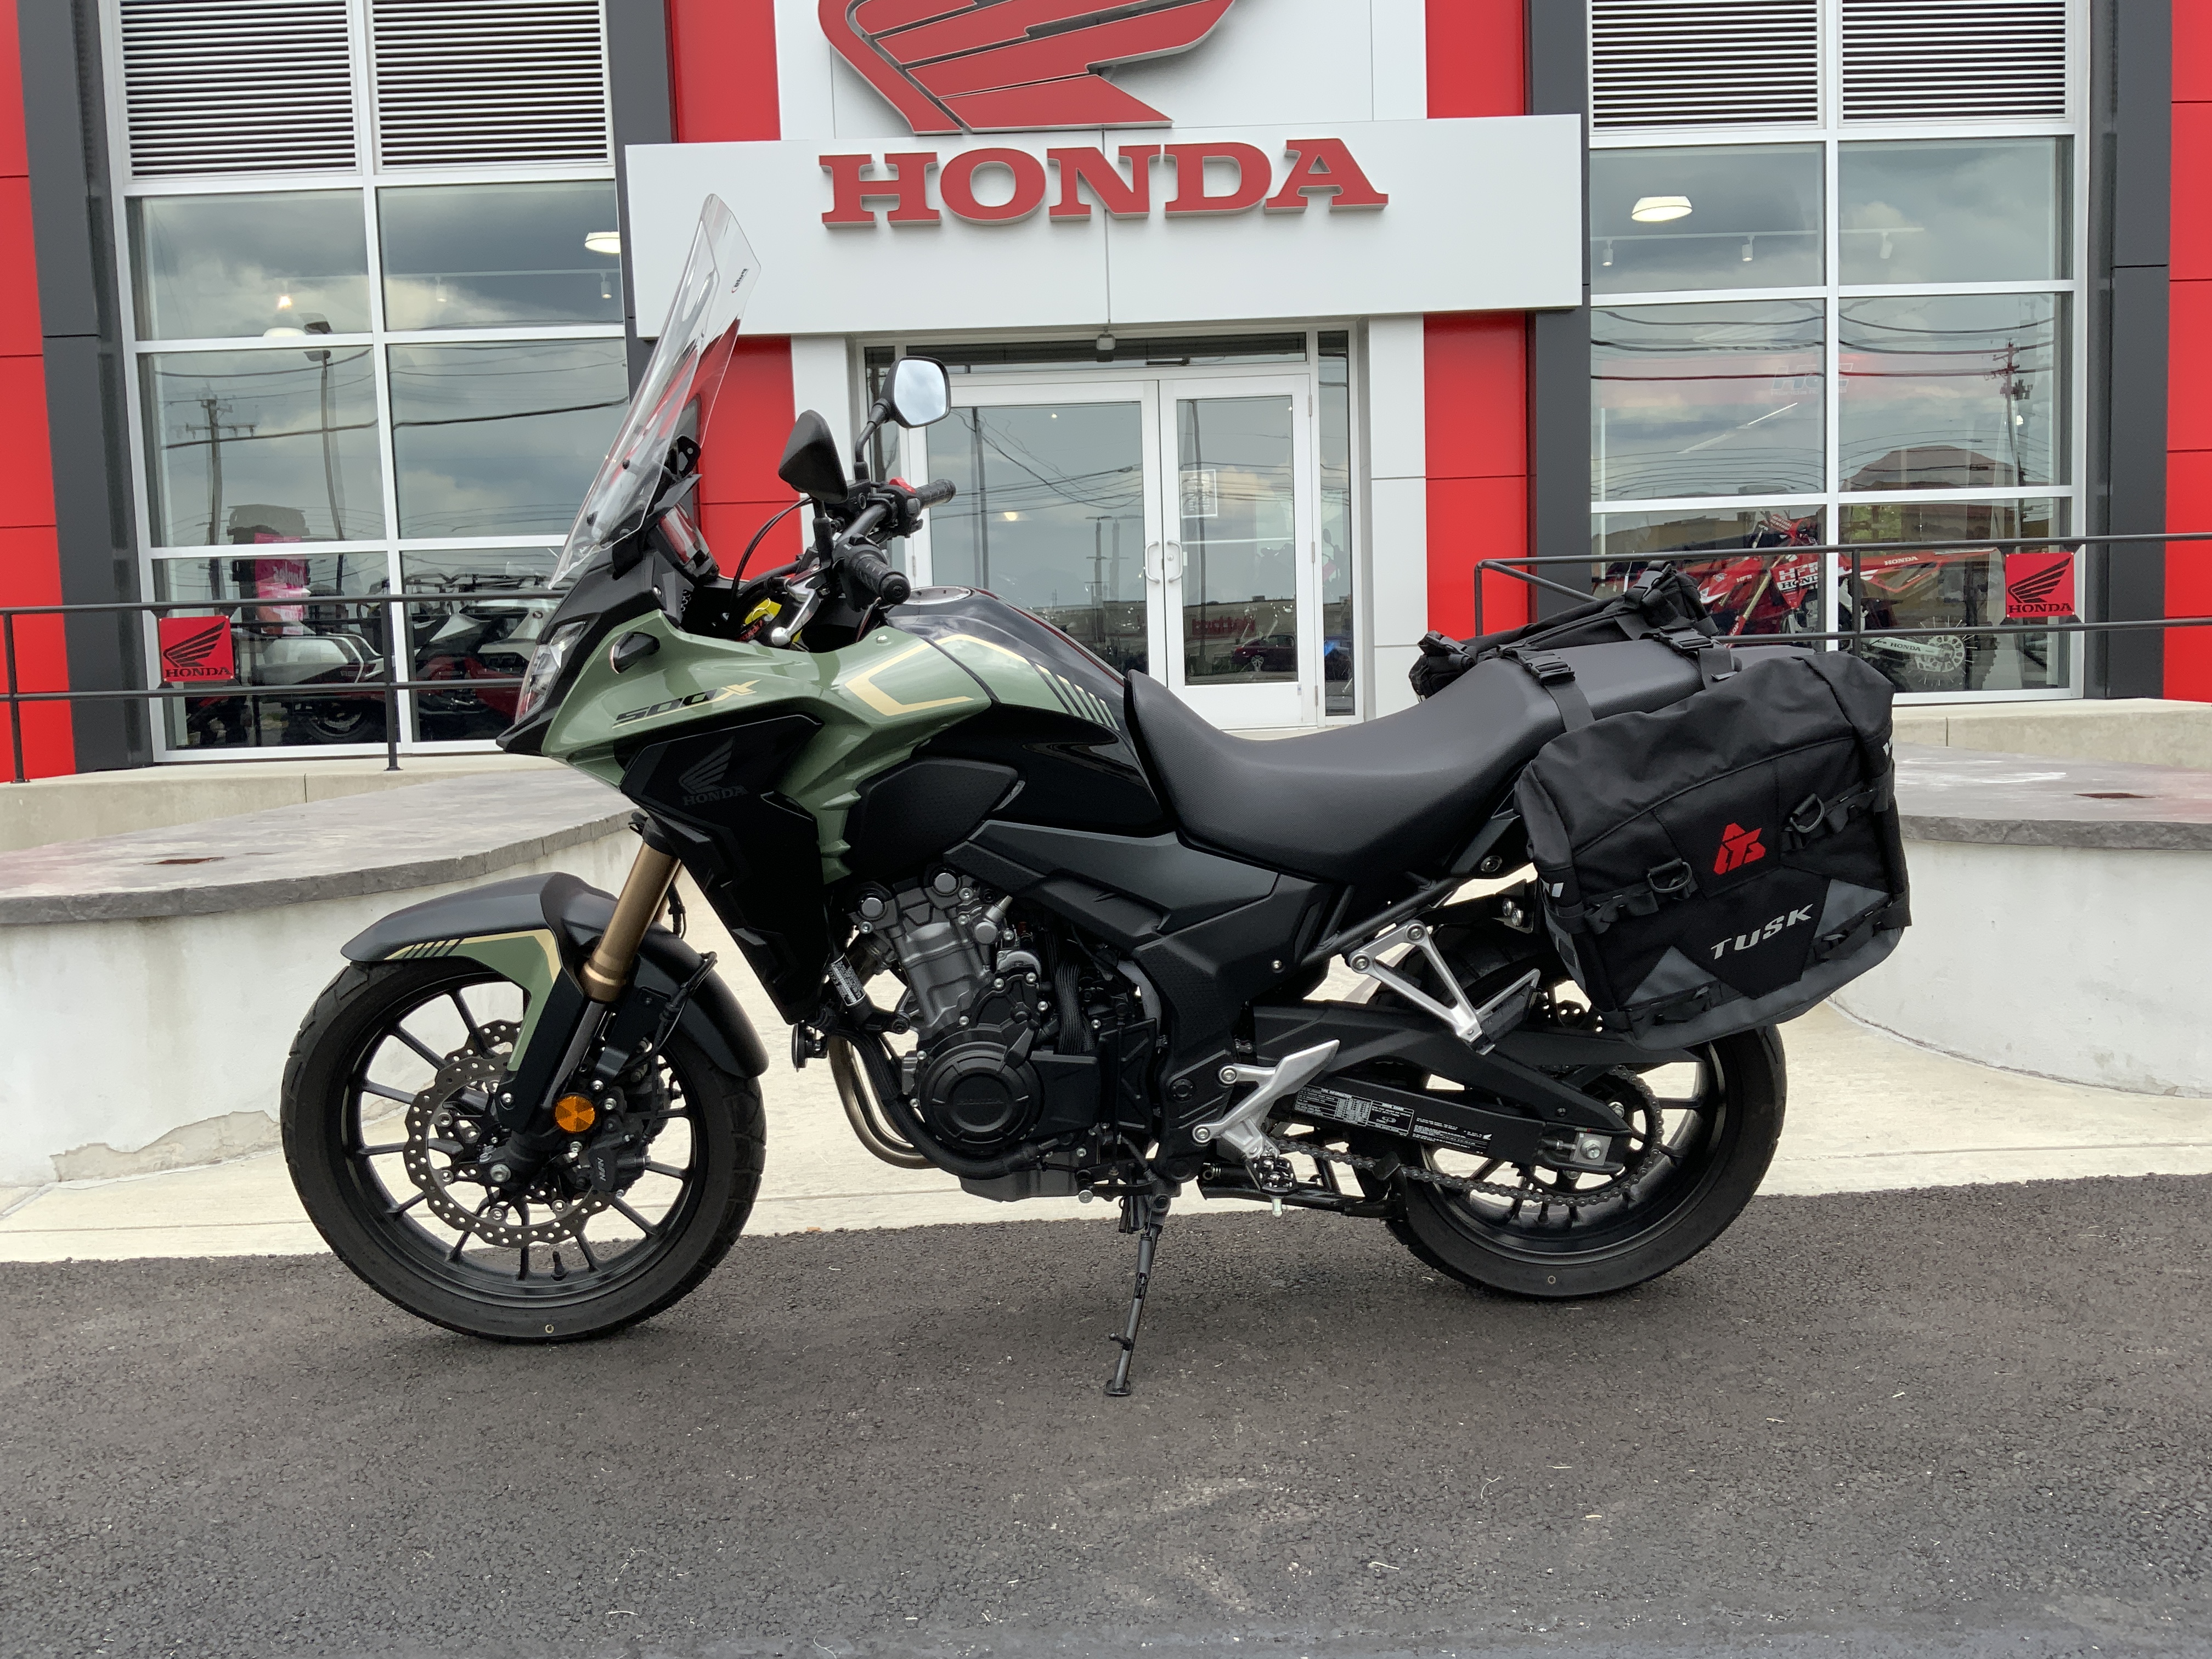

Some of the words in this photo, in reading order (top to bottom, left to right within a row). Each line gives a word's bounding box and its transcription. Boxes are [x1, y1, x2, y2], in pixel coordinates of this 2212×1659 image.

[819, 138, 1389, 228] HONDA
[1884, 556, 1918, 566] HONDA
[1781, 576, 1818, 589] HOND
[2008, 602, 2073, 613] HONDA
[1890, 642, 1921, 651] HONDA
[165, 667, 232, 677] HONDA
[682, 785, 749, 806] HONDA
[1710, 904, 1814, 960] TUSK
